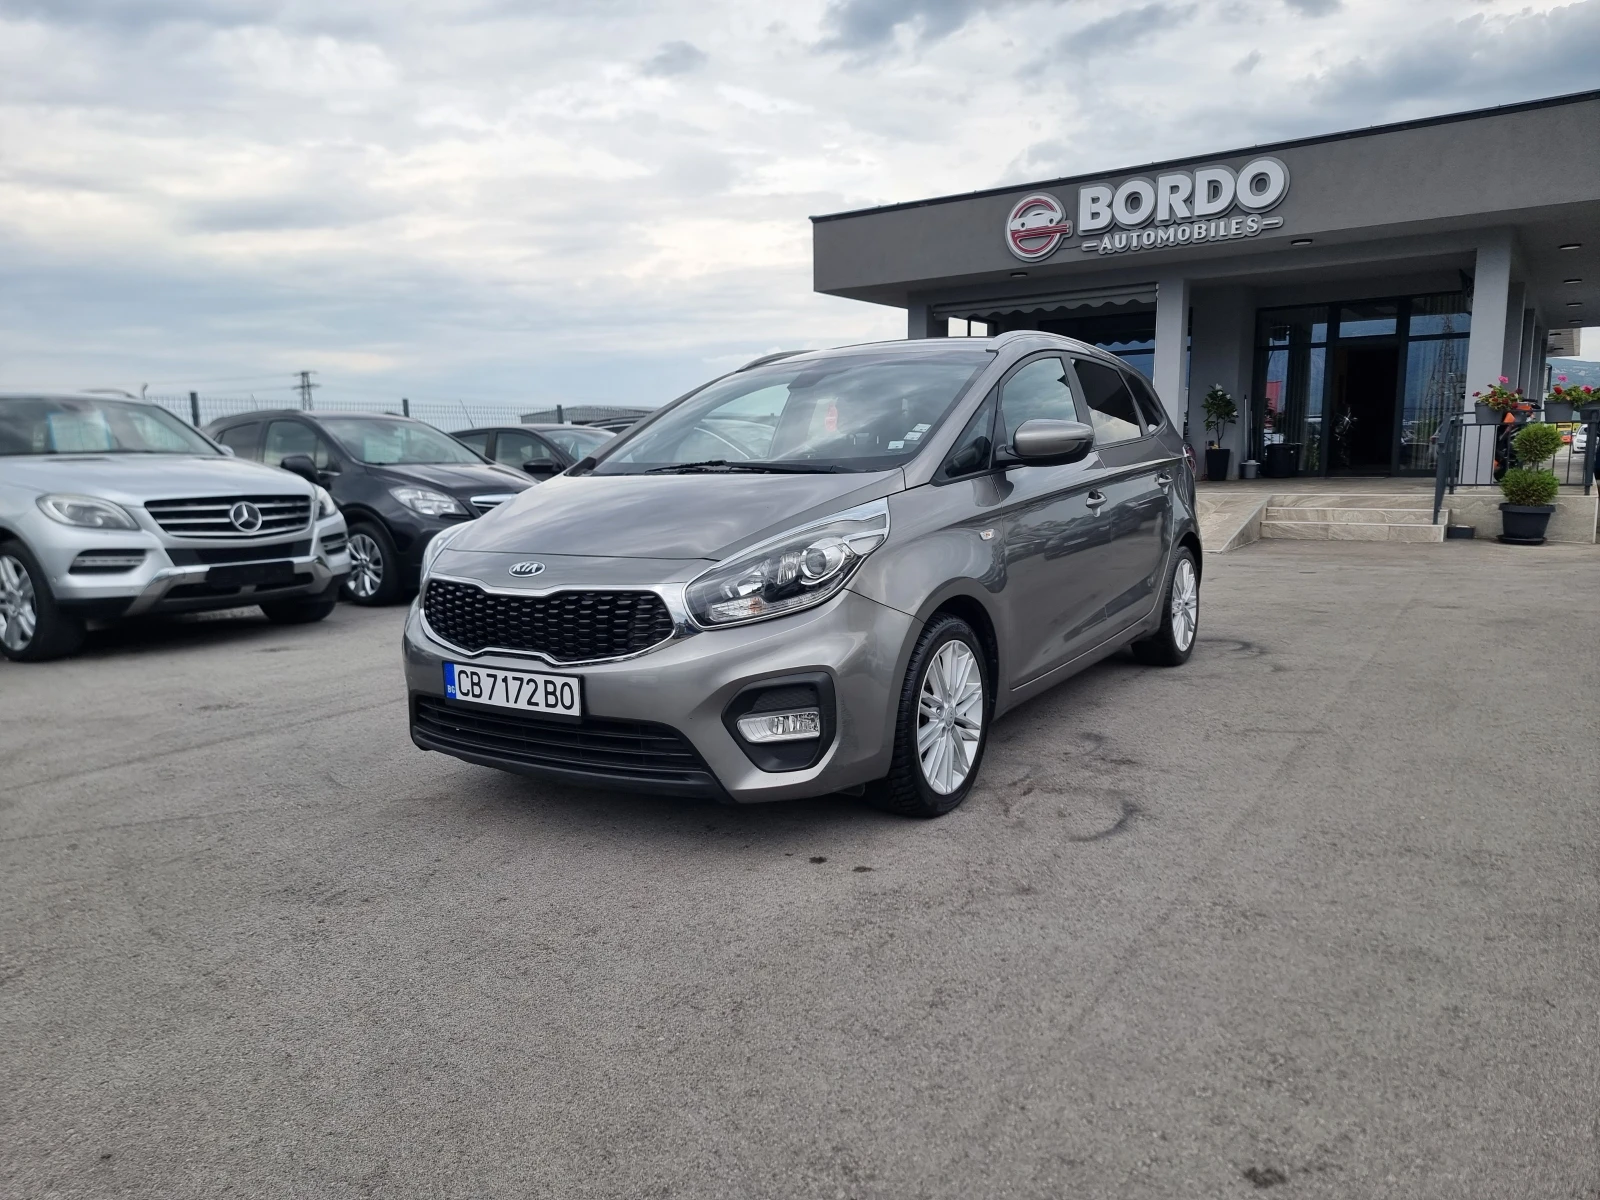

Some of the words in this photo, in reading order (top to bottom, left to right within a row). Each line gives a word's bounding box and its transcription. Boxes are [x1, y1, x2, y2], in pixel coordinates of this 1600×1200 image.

[1079, 159, 1286, 232] BORDO
[512, 562, 539, 573] KIA
[447, 684, 456, 694] BG
